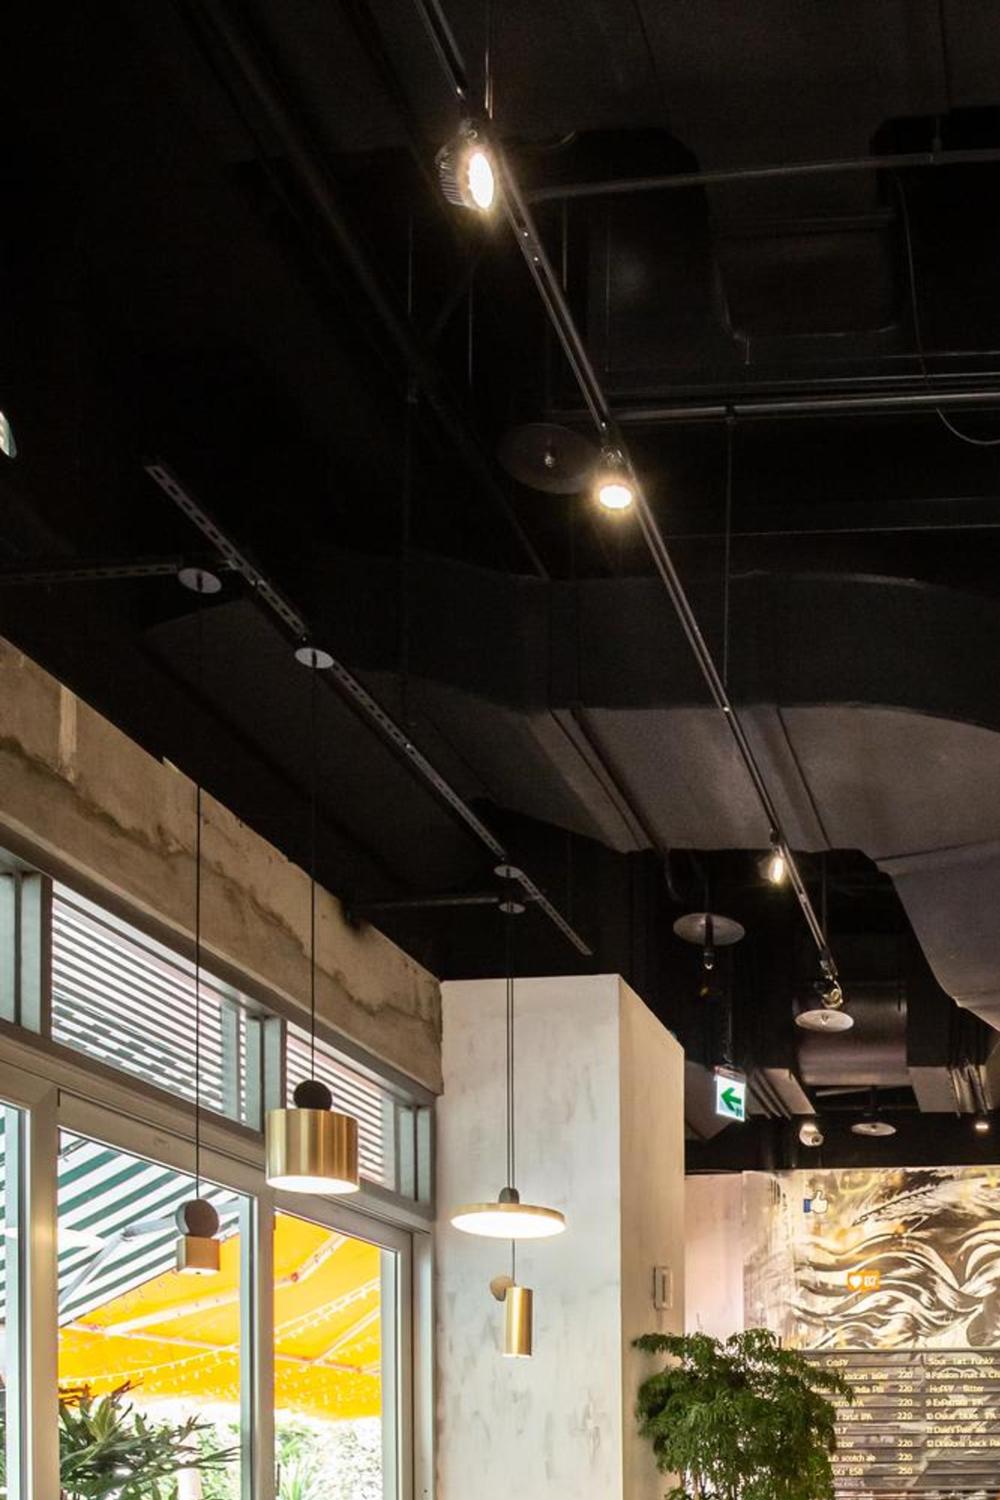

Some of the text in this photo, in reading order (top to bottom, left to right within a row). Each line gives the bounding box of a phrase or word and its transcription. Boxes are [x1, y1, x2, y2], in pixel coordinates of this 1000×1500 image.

[898, 1384, 913, 1393] 220
[898, 1398, 913, 1407] 220
[898, 1411, 913, 1420] 220
[898, 1438, 913, 1448] 220
[898, 1452, 913, 1462] 220
